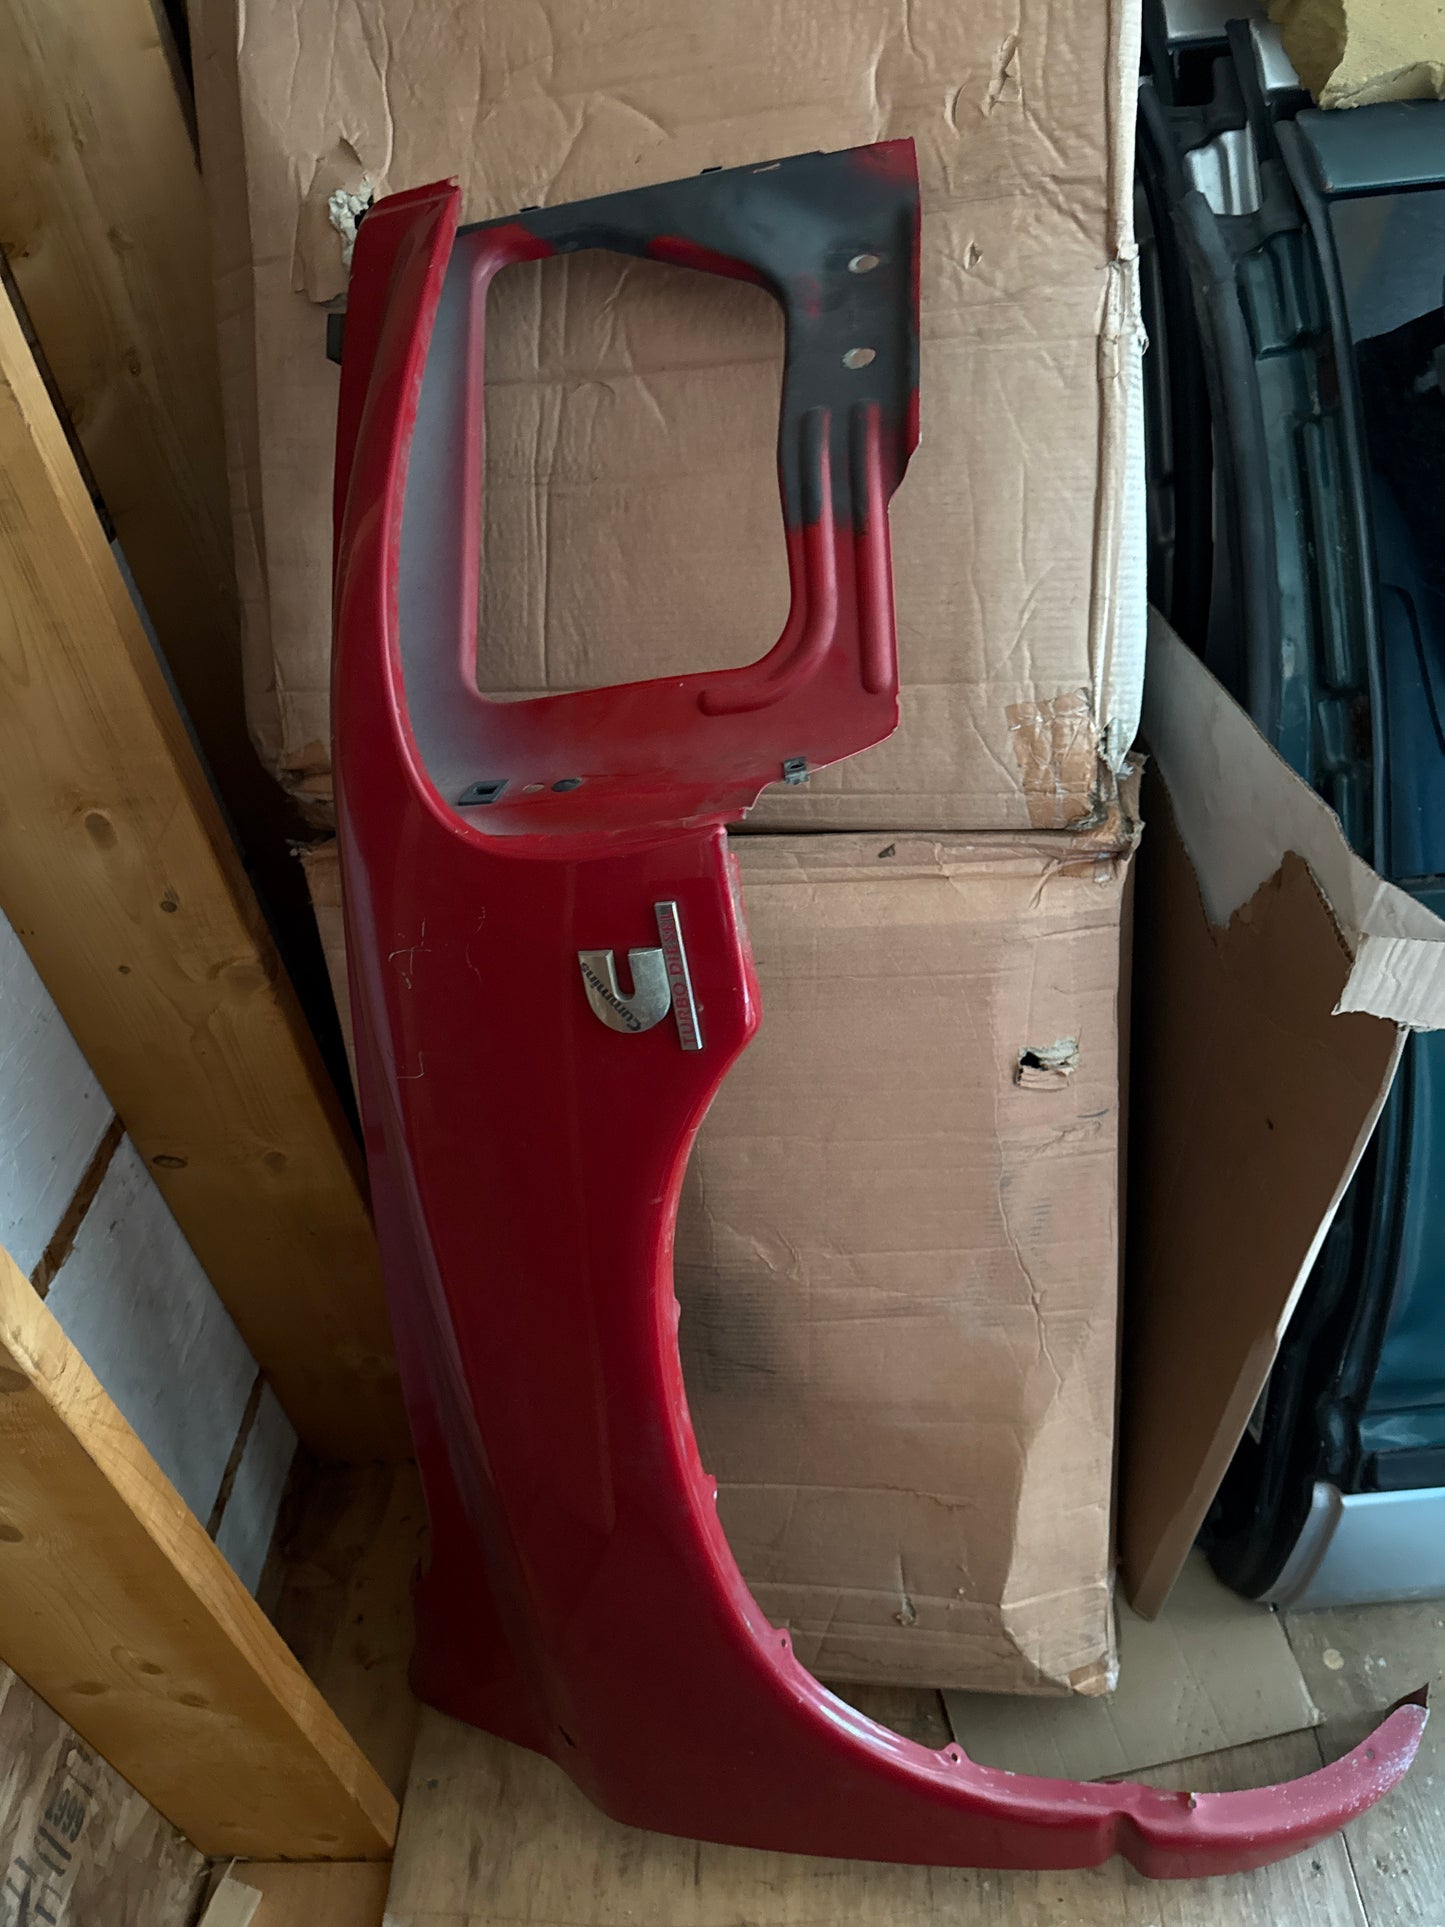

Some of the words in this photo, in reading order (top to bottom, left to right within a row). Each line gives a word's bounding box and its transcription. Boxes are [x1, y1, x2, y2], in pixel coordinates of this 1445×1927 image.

[660, 909, 684, 977] DIESEL
[581, 962, 642, 1032] Cummins
[672, 982, 696, 1046] TURBO
